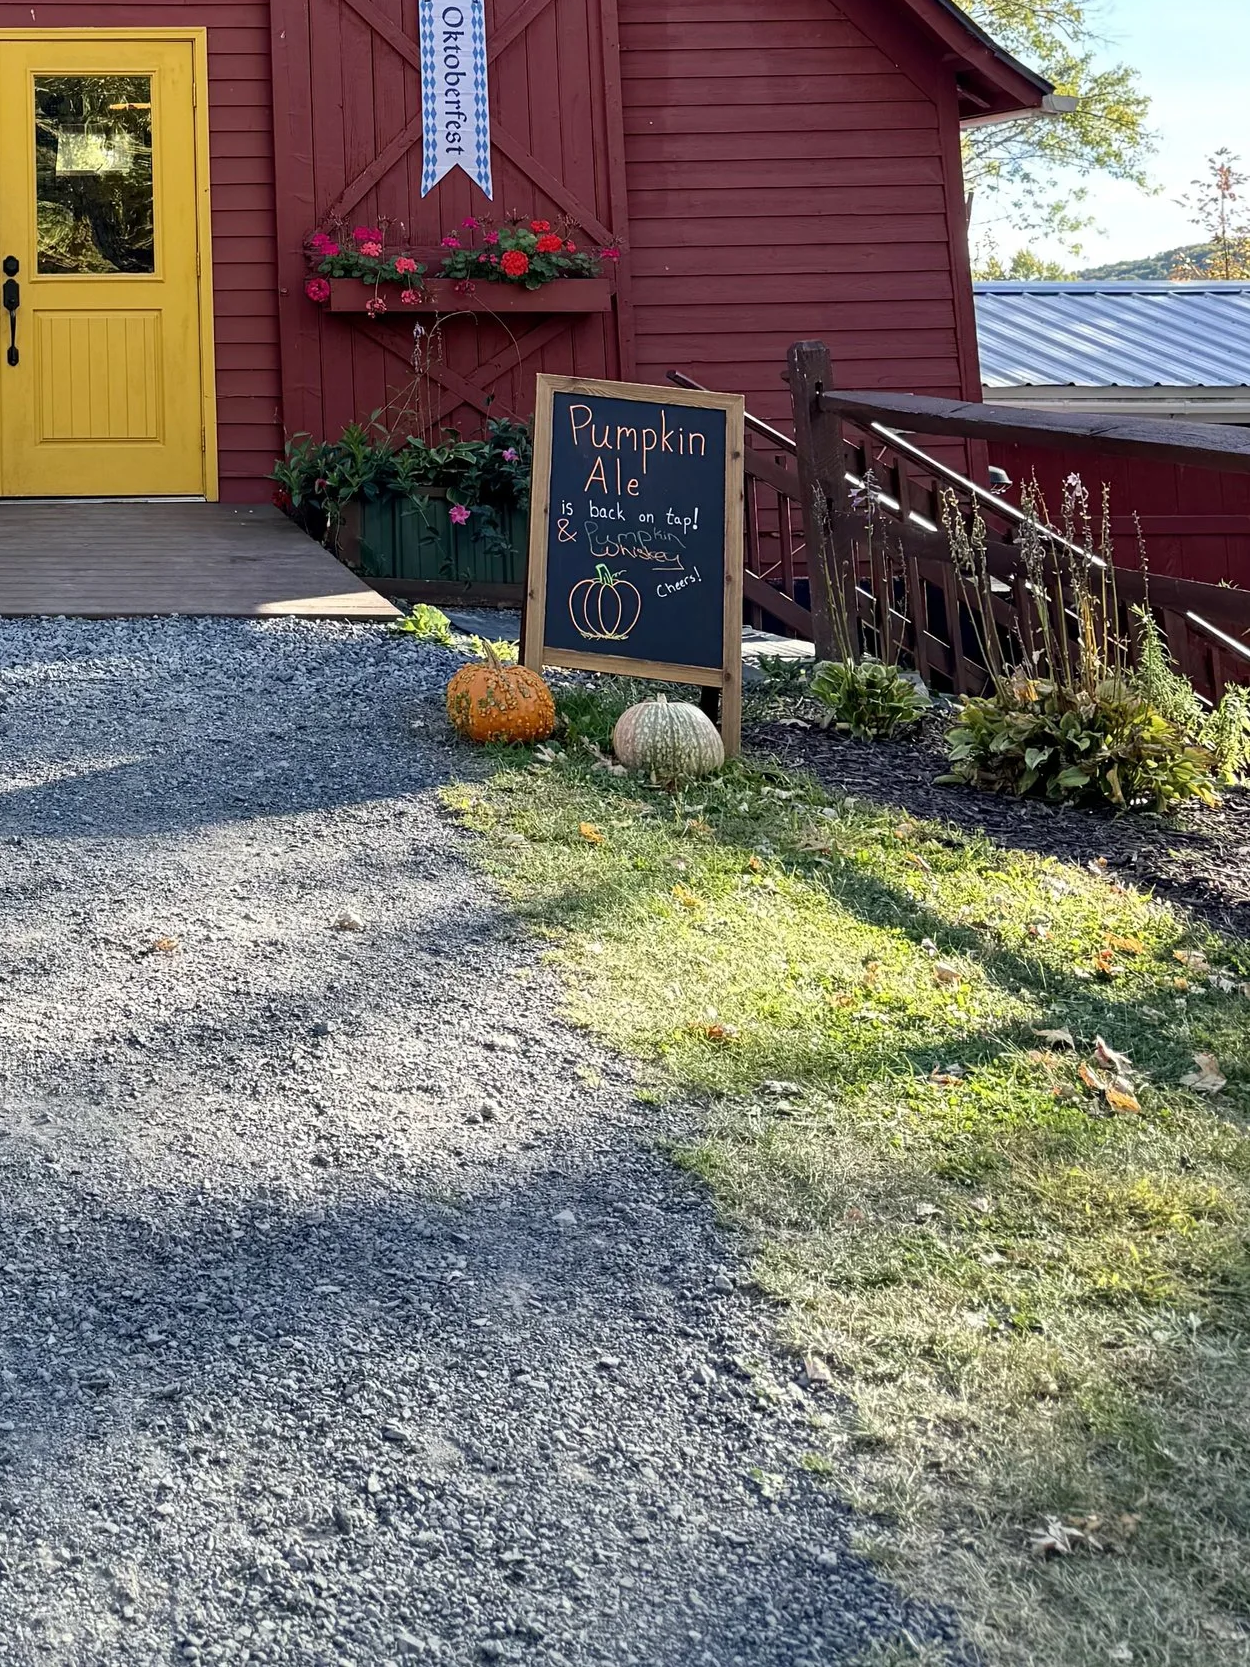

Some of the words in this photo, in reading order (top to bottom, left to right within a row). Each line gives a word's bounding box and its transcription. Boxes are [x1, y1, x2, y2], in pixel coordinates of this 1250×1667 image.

[442, 6, 467, 157] Oktoberfest
[569, 404, 706, 474] Pumpkin
[584, 456, 640, 497] Ale
[557, 518, 578, 543] &
[584, 520, 686, 550] Pumpkin
[561, 499, 574, 516] is
[589, 499, 626, 522] back
[638, 510, 655, 524] on
[666, 507, 699, 535] tap!
[589, 542, 684, 570] Whiskey
[656, 566, 702, 598] Cheers!
